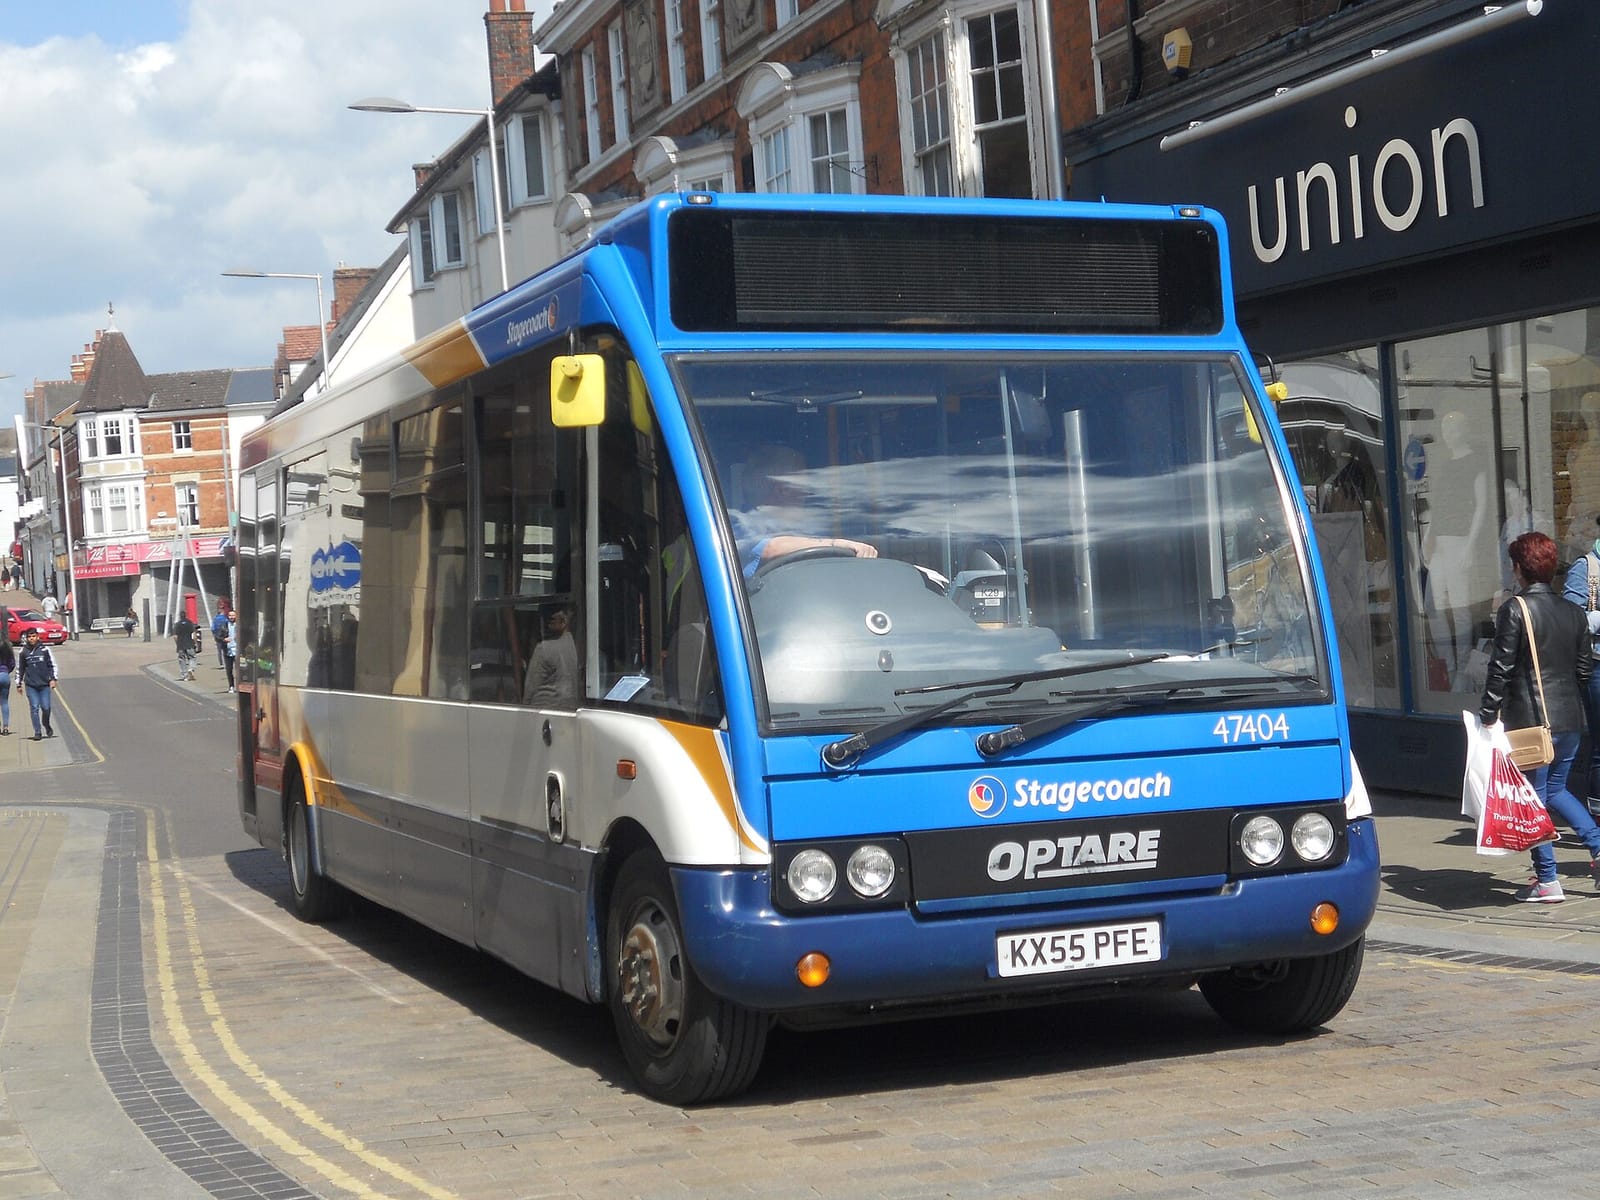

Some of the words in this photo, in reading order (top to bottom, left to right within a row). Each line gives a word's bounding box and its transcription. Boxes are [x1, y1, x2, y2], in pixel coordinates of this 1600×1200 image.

[1247, 105, 1484, 263] union
[506, 306, 548, 347] Stagecoach
[1212, 712, 1290, 744] 47404
[1012, 771, 1171, 812] Stagecoach
[987, 829, 1161, 881] OPTARE
[1010, 933, 1086, 969] KX55
[1094, 927, 1148, 960] PFE
